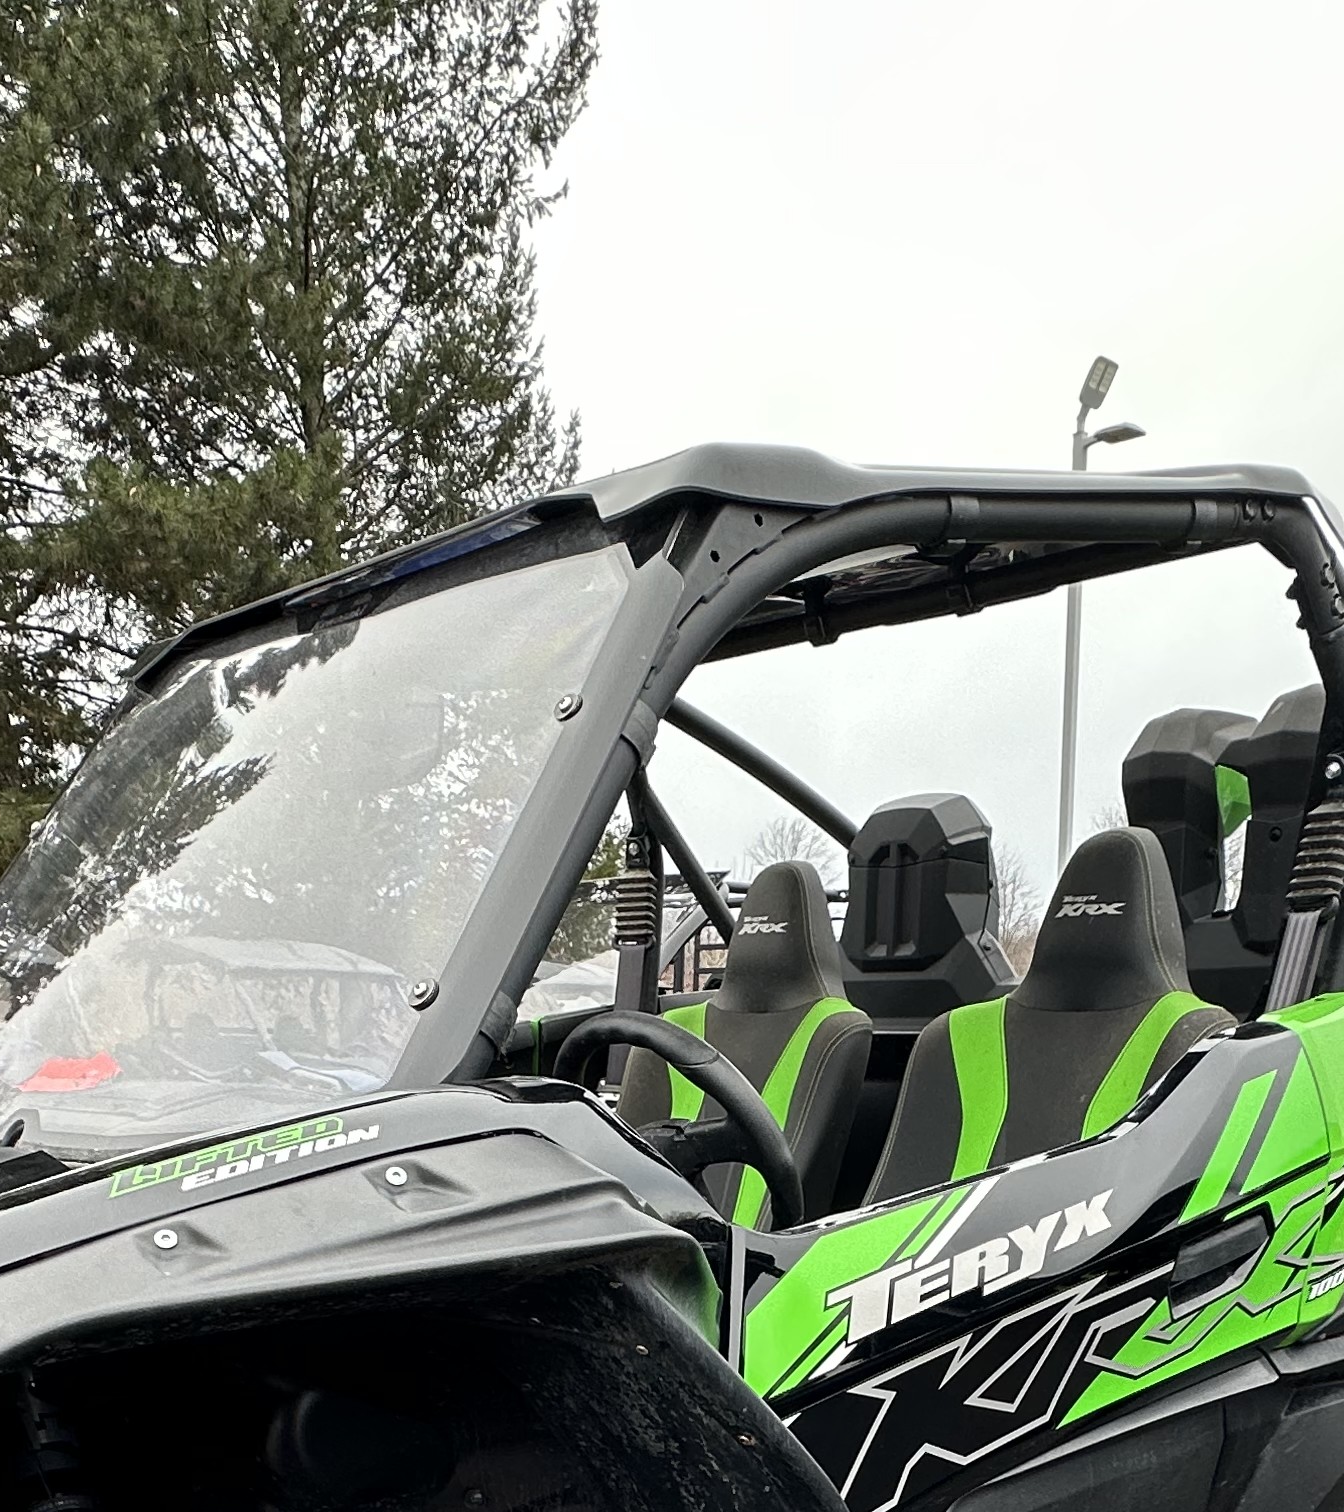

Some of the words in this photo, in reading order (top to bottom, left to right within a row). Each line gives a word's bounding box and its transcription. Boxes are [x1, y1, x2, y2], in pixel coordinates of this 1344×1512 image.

[1054, 902, 1126, 918] KRX
[108, 1115, 344, 1199] LIFTED
[180, 1124, 381, 1192] EDITION
[825, 1187, 1115, 1345] TERYX
